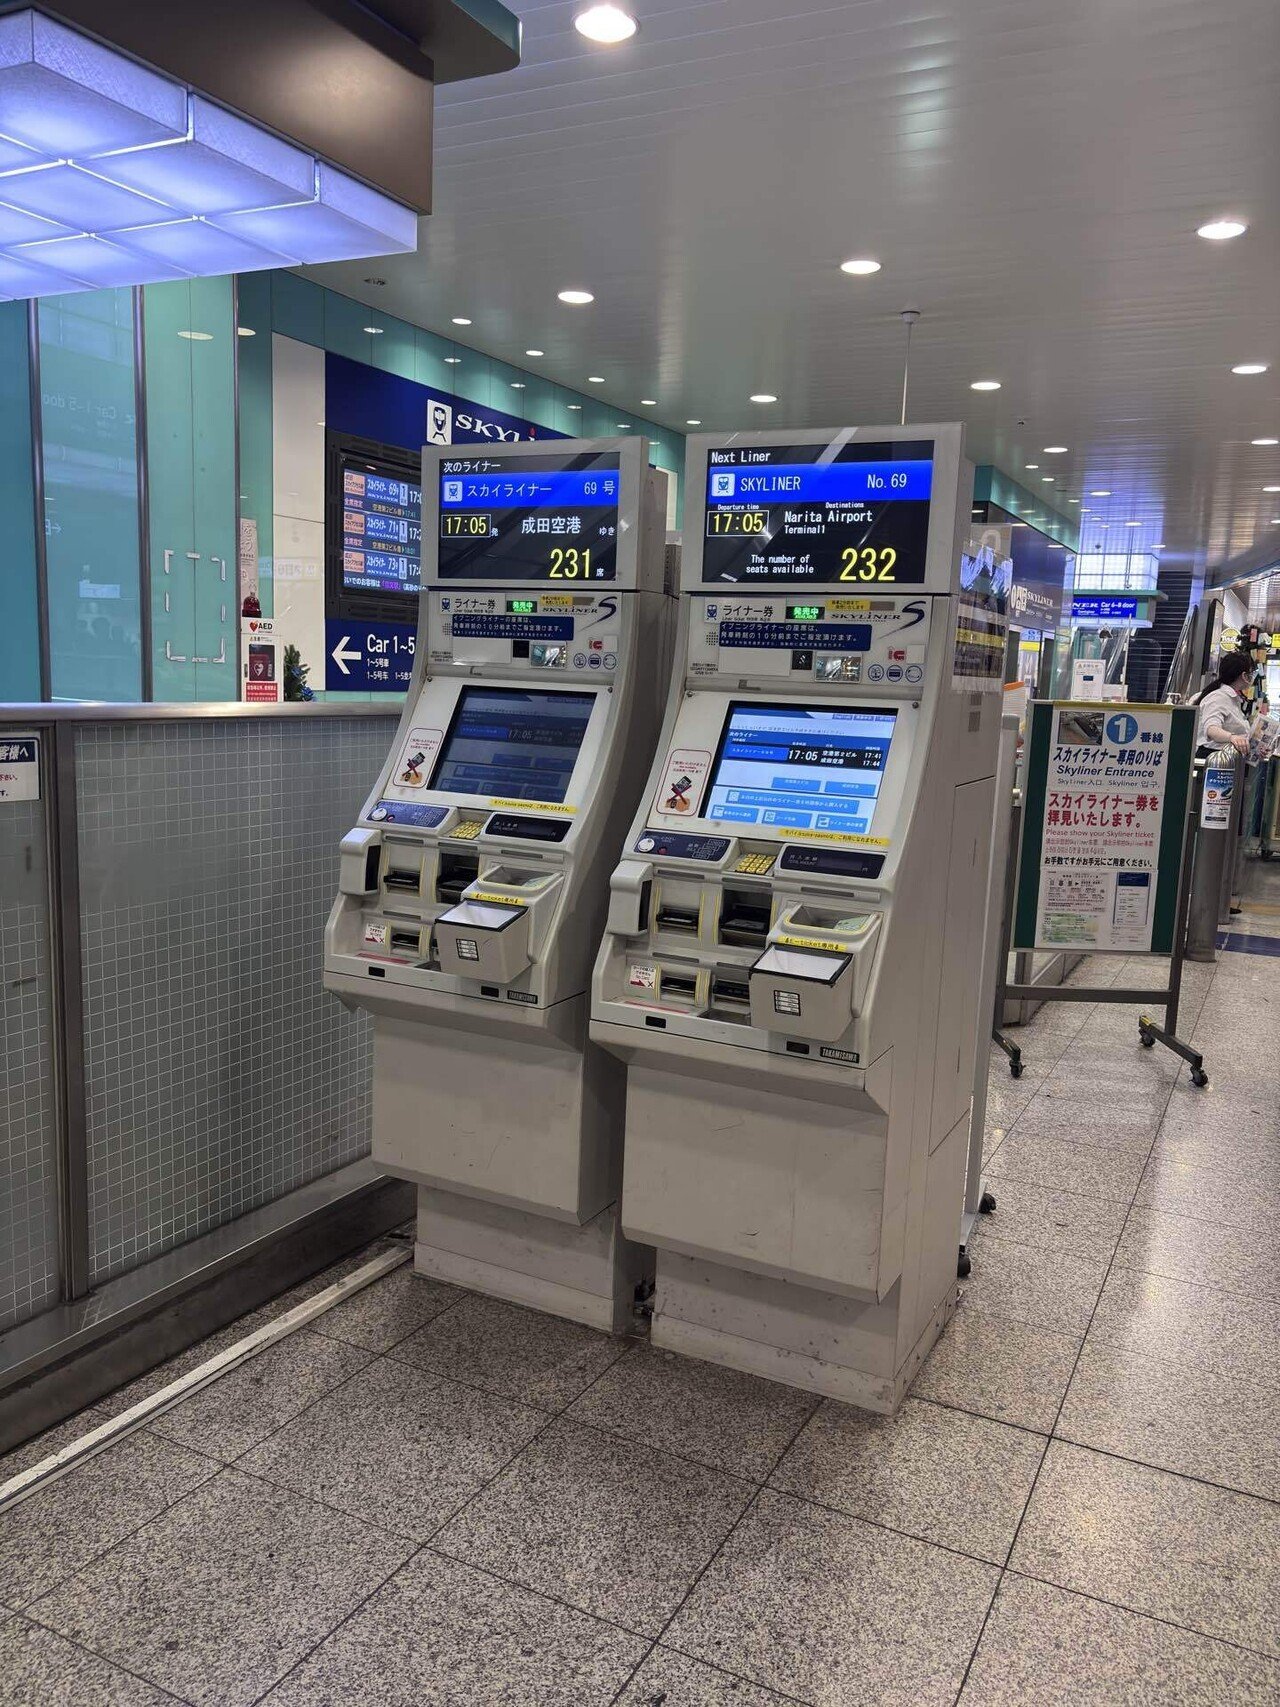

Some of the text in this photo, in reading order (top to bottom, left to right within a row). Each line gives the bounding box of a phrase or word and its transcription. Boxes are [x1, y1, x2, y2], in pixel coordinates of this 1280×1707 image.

[711, 451, 771, 462] Next Liner
[444, 462, 501, 472] 次のライナー
[467, 480, 616, 497] スカイライナー 69 号
[740, 473, 907, 492] SKYLINER No. 69
[713, 513, 764, 533] 17:05
[784, 510, 873, 524] Narita Airport
[446, 516, 498, 537] 17:05 発
[521, 516, 616, 536] 成田空港 ゆき
[549, 548, 604, 578] 231 席
[751, 554, 810, 564] The number of
[840, 548, 897, 581] 232
[746, 564, 814, 573] seats available
[454, 598, 496, 610] ライナー券
[542, 606, 598, 614] SKYLINER
[723, 605, 774, 617] ライナー券
[831, 612, 901, 620] SKYLINER
[258, 622, 273, 630] AED
[367, 634, 416, 655] Car 1~5
[1114, 717, 1164, 744] 1 番線
[788, 750, 818, 761] 17:05
[1053, 746, 1164, 766] スカイライナー専用のりば
[1056, 764, 1154, 778] Skyliner Entrance
[1108, 780, 1138, 788] Skyliner
[1048, 793, 1159, 811] スカイライナー券を
[1047, 810, 1140, 828] 拝見いたします。
[1108, 830, 1133, 838] Skyliner
[1044, 856, 1153, 868] お手数ですがお手元にご用意ください。
